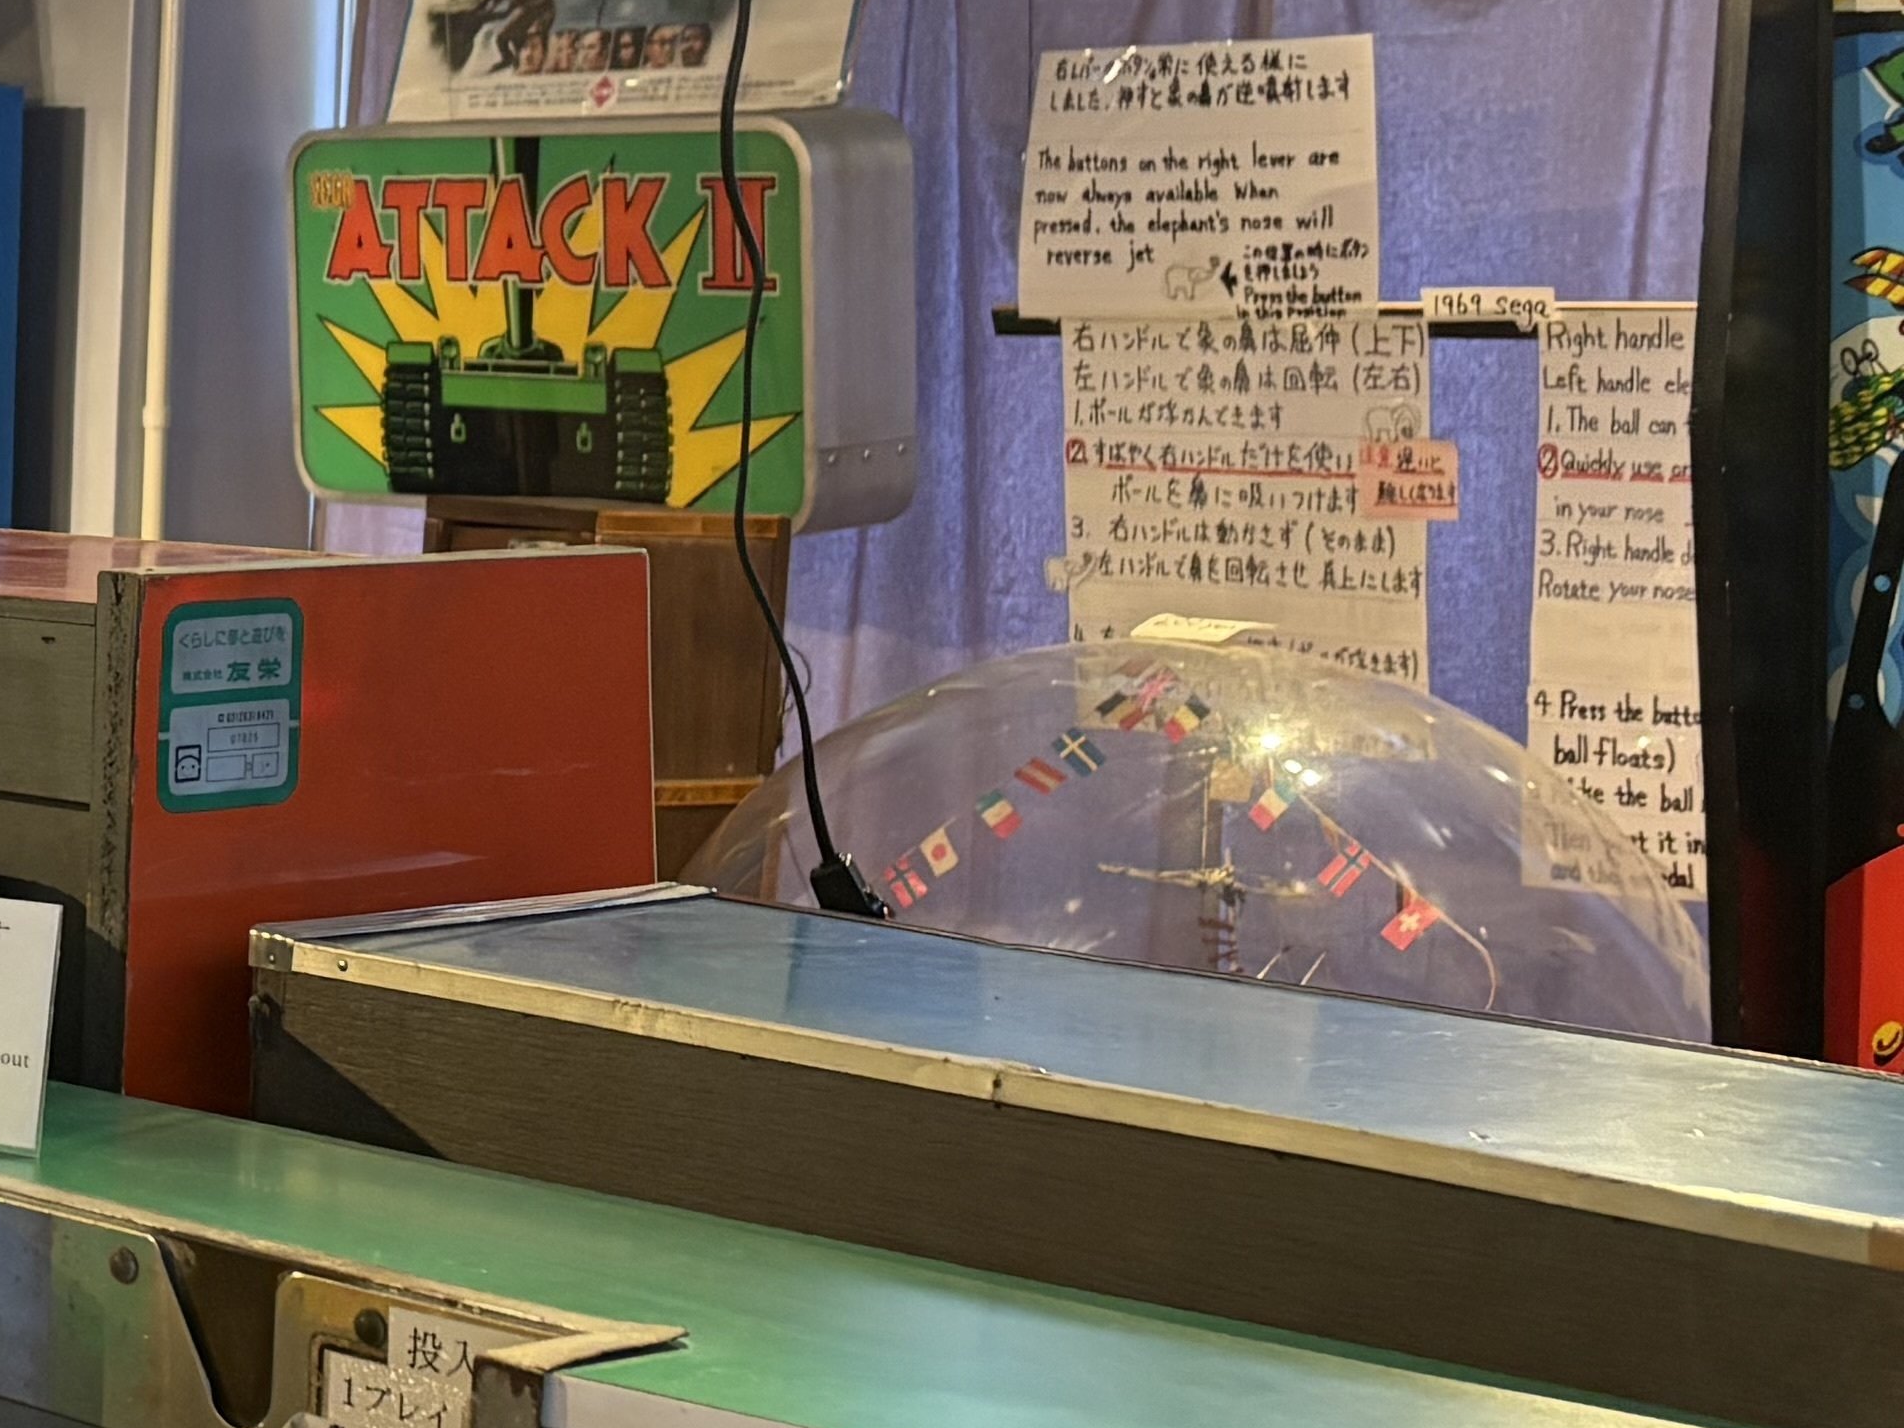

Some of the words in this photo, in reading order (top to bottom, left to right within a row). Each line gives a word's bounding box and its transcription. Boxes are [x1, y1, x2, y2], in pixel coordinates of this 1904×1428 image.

[1039, 148, 1061, 172] The
[1163, 146, 1189, 172] the
[1198, 150, 1240, 177] right
[326, 175, 672, 289] ATTACK
[1433, 293, 1482, 317] 1969
[1547, 323, 1608, 358] Right
[1615, 317, 1685, 351] handle
[1543, 363, 1588, 394] Left
[1597, 365, 1651, 393] handle
[1568, 405, 1599, 433] The
[1611, 406, 1640, 435] ball
[1648, 418, 1677, 435] can
[1561, 449, 1625, 476] Quickly
[1555, 496, 1573, 517] in
[1578, 502, 1618, 526] your
[1625, 505, 1665, 522] nose
[1567, 532, 1617, 565] Right
[1624, 533, 1674, 563] handle
[1539, 568, 1601, 599] Rotate
[1609, 578, 1647, 603] your
[1561, 689, 1606, 722] Press
[1614, 692, 1644, 723] the
[1553, 733, 1589, 767] ball
[1594, 737, 1677, 773] floats)
[1614, 778, 1647, 809] the
[1660, 782, 1693, 814] ball
[1658, 830, 1678, 855] it
[0, 1050, 30, 1069] out
